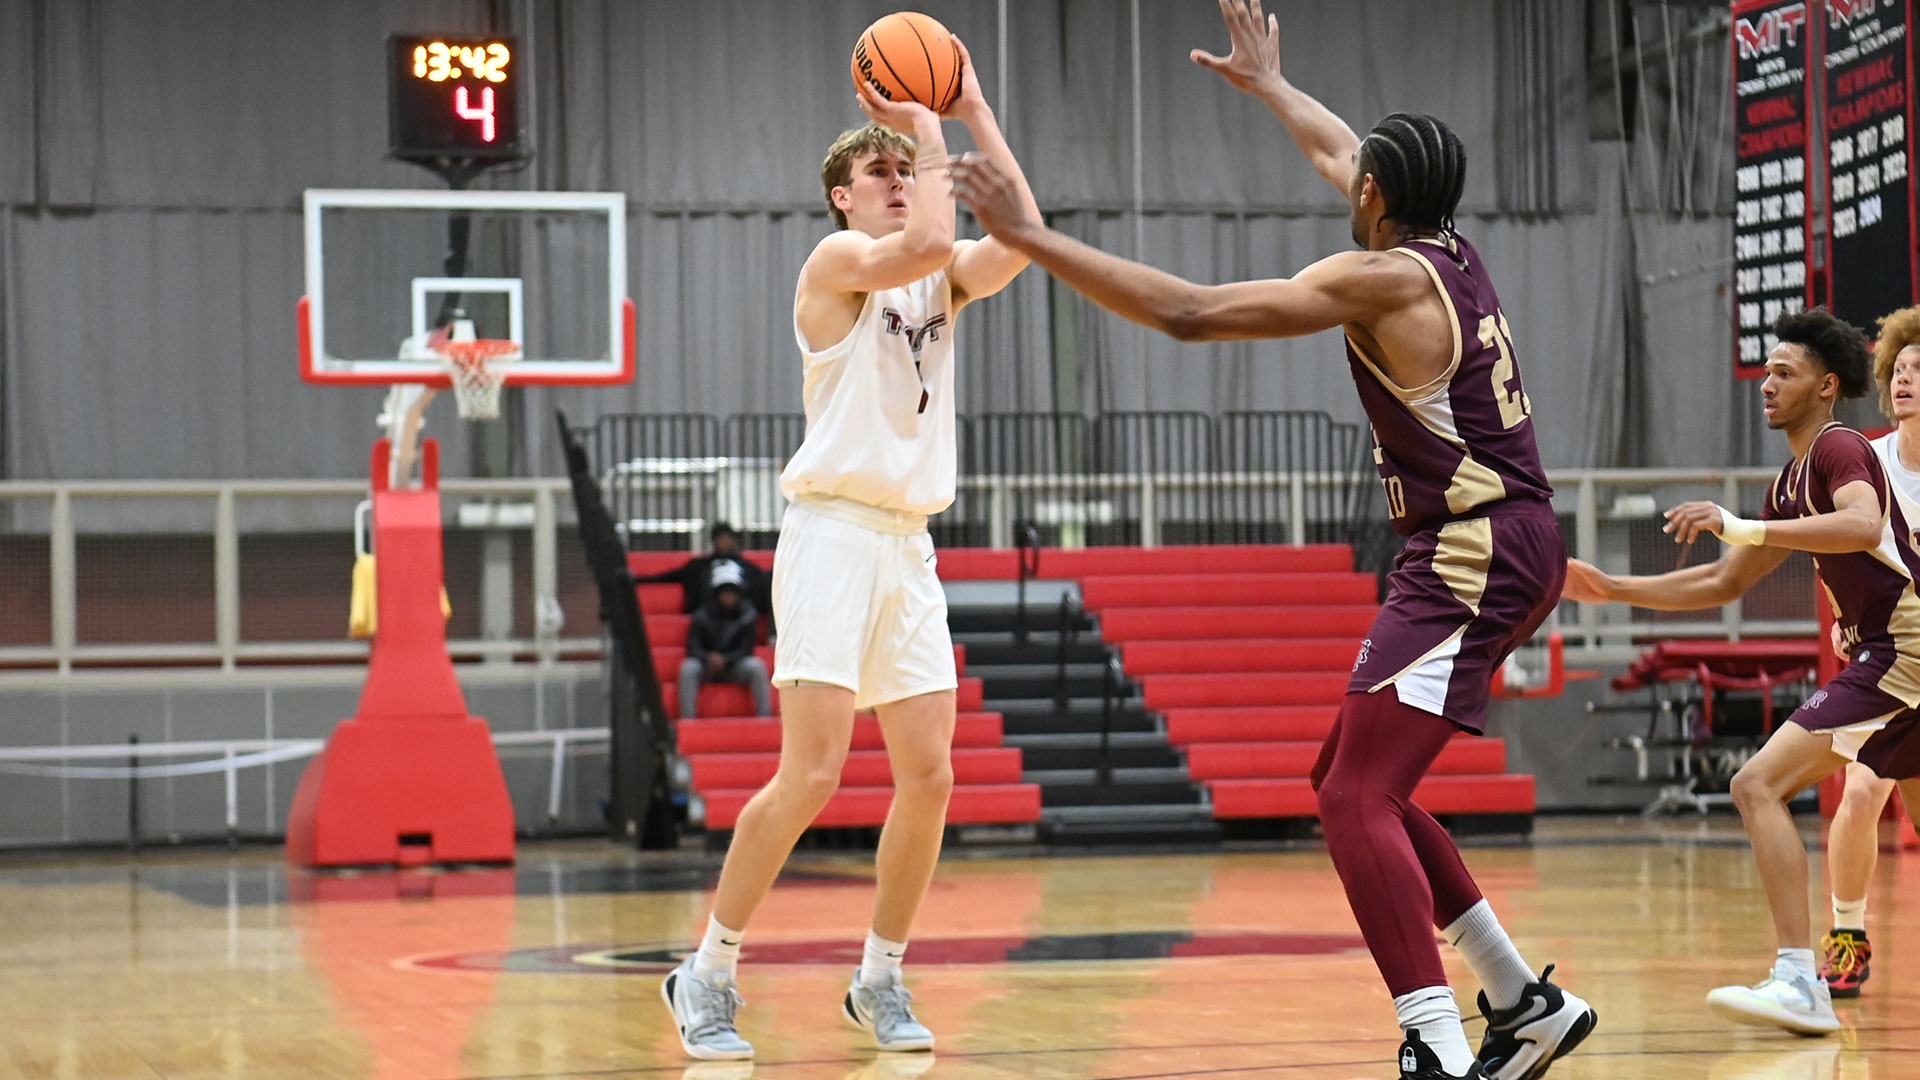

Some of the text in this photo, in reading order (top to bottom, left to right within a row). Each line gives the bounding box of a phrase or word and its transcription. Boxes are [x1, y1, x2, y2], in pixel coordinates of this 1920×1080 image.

[1736, 3, 1806, 60] MIT
[413, 42, 510, 82] 13:42
[855, 38, 892, 101] Wilson
[455, 85, 495, 142] 4
